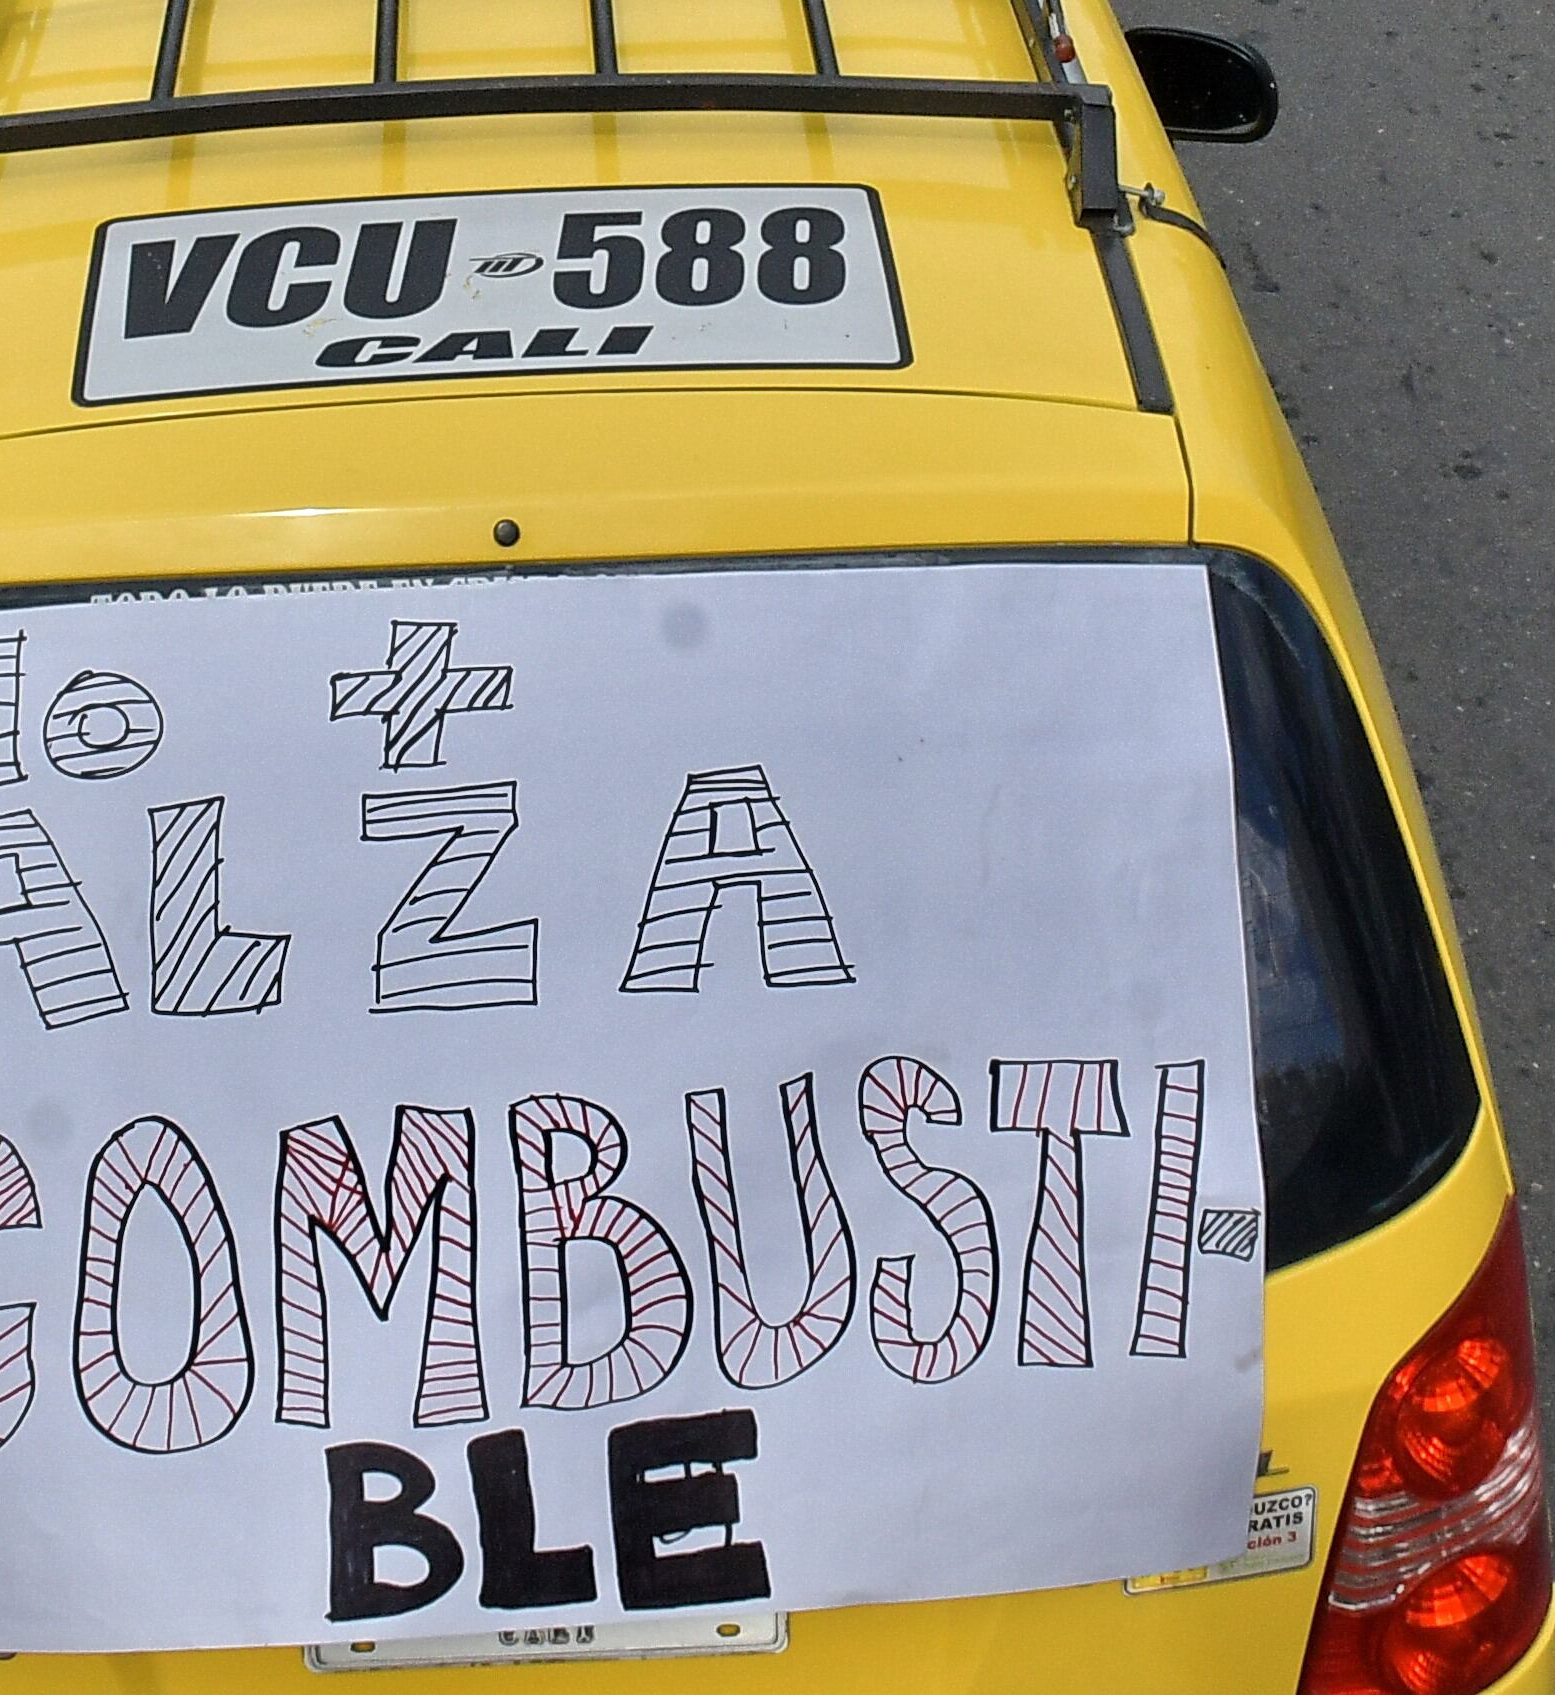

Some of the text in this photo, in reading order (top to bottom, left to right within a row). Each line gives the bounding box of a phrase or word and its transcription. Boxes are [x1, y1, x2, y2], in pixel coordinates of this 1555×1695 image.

[124, 206, 845, 339] VCU 588
[314, 325, 654, 368] CALI
[325, 1409, 773, 1621] BLE
[1250, 1493, 1313, 1516] UZCO?
[1247, 1511, 1304, 1533] RATIS
[1247, 1531, 1297, 1550] ción 3
